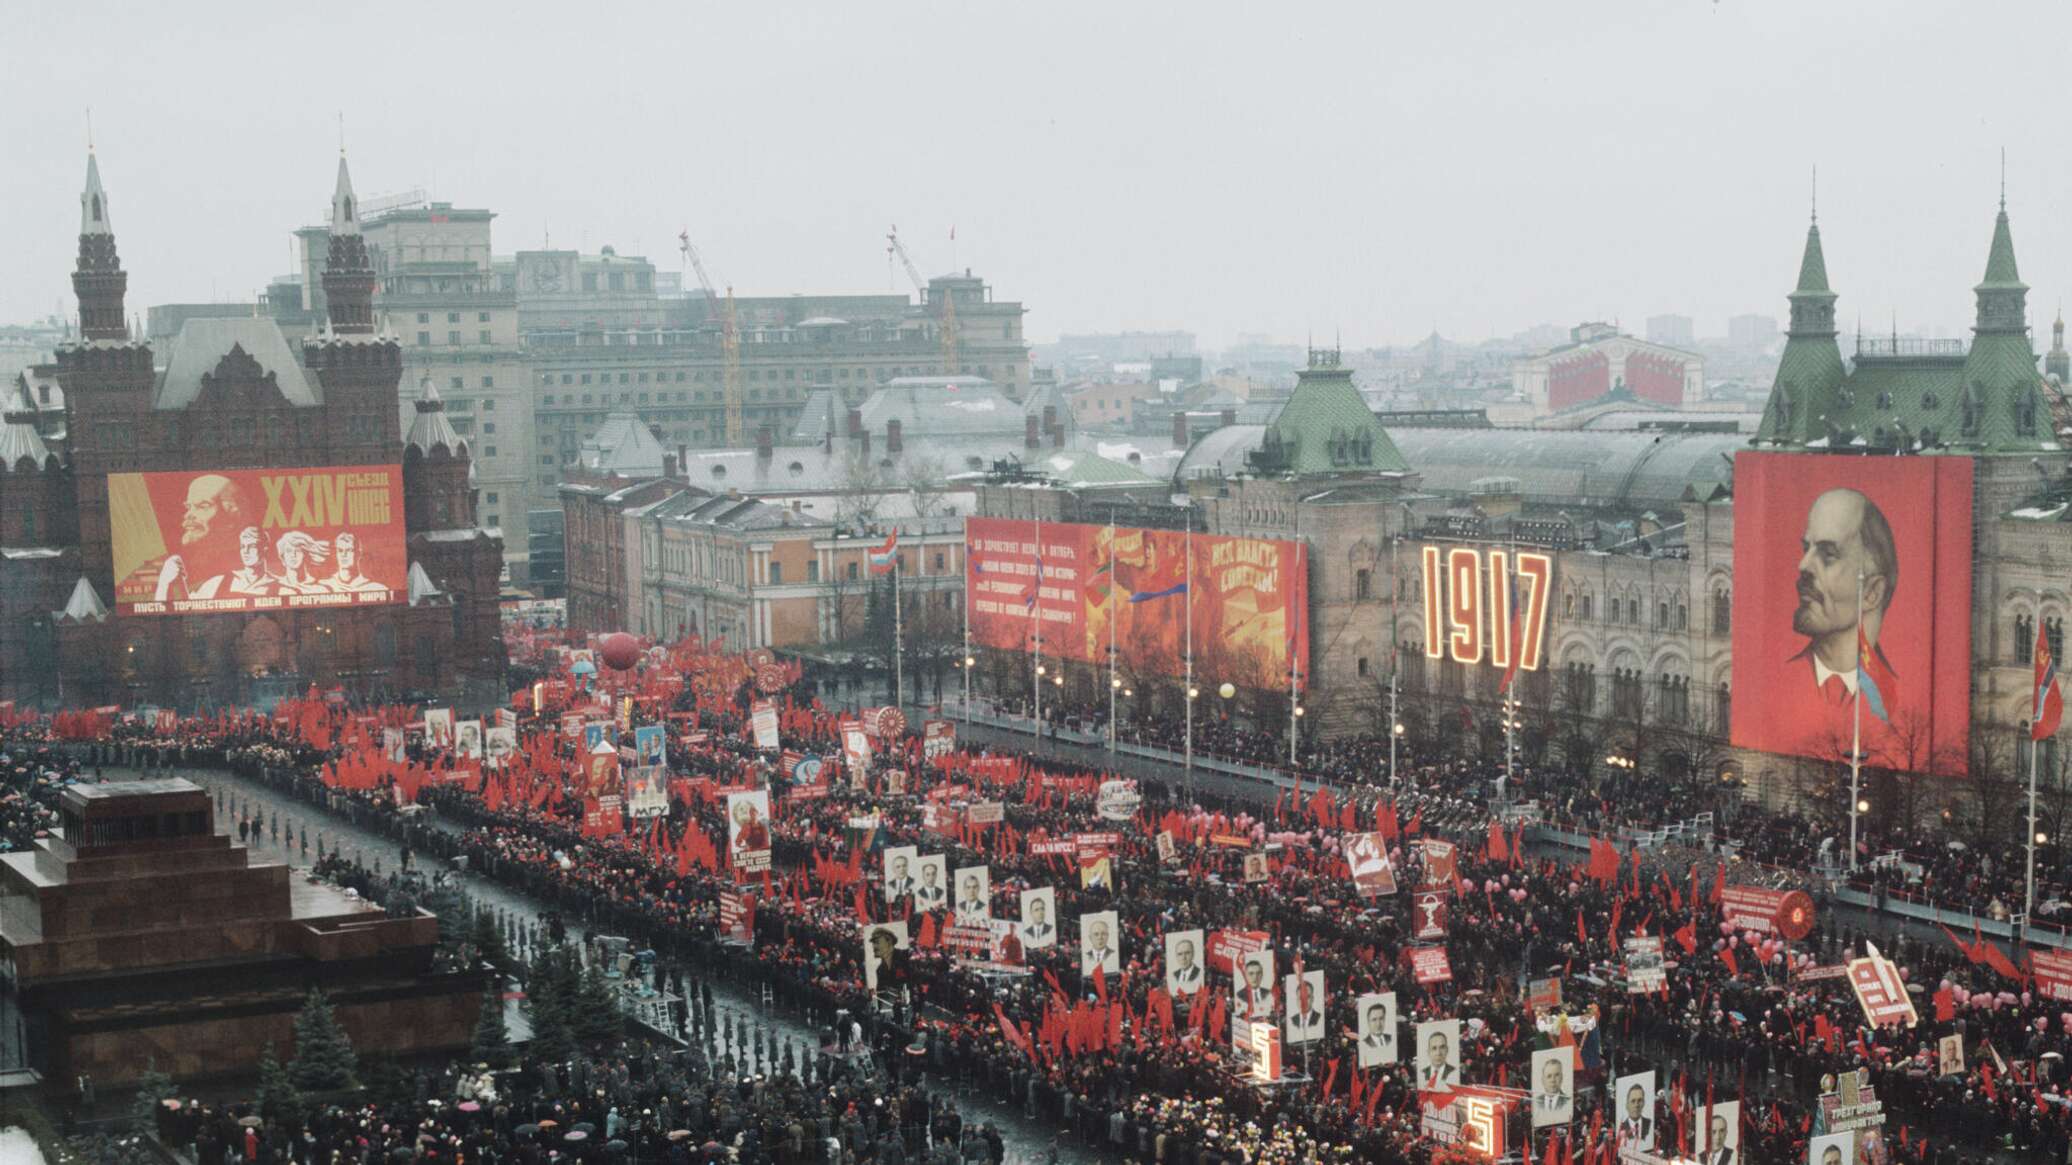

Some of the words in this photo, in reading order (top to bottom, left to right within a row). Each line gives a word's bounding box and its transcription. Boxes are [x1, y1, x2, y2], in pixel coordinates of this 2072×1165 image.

[260, 474, 347, 528] XXIV
[348, 488, 390, 525] КПСС
[1212, 541, 1234, 567] ВСЯ
[1236, 540, 1278, 568] ВЛАСТЬ
[134, 601, 166, 613] ПУСТЬ
[173, 598, 246, 611] ТОРЖЕСТВУЮТ
[289, 593, 351, 606] ПРОГРАММЫ
[1423, 546, 1551, 671] 1917
[634, 806, 667, 817] МГУ
